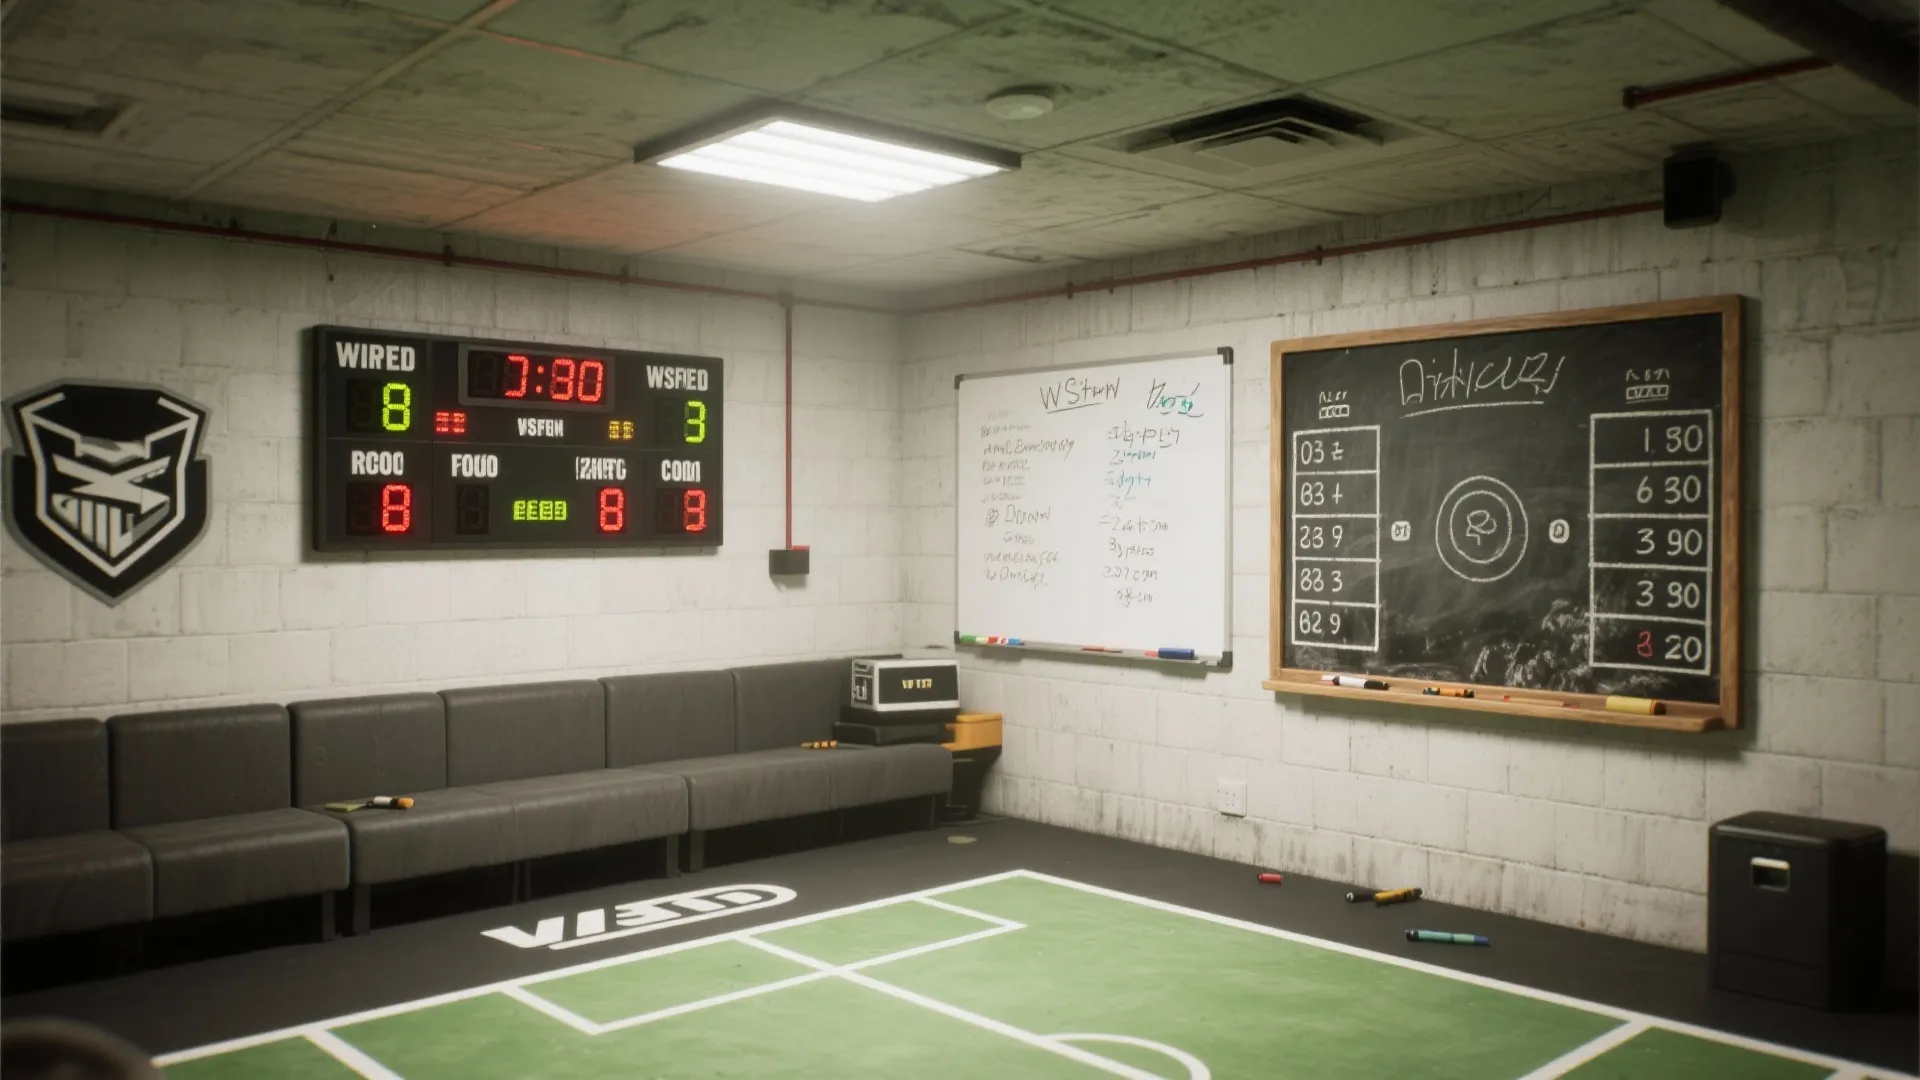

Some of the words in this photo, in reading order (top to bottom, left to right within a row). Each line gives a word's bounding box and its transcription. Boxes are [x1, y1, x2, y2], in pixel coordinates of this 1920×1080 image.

[336, 341, 416, 372] WIRED
[382, 382, 411, 431] 8
[1636, 475, 1653, 504] 6
[1664, 474, 1702, 504] 30
[382, 483, 411, 532] 8
[599, 487, 625, 532] 8
[1332, 525, 1343, 548] 9
[1636, 527, 1655, 555] 3
[1666, 528, 1703, 556] 90
[1331, 570, 1343, 592] 3
[1635, 580, 1654, 607] 3
[1329, 612, 1341, 635] 9
[1664, 634, 1702, 662] 20
